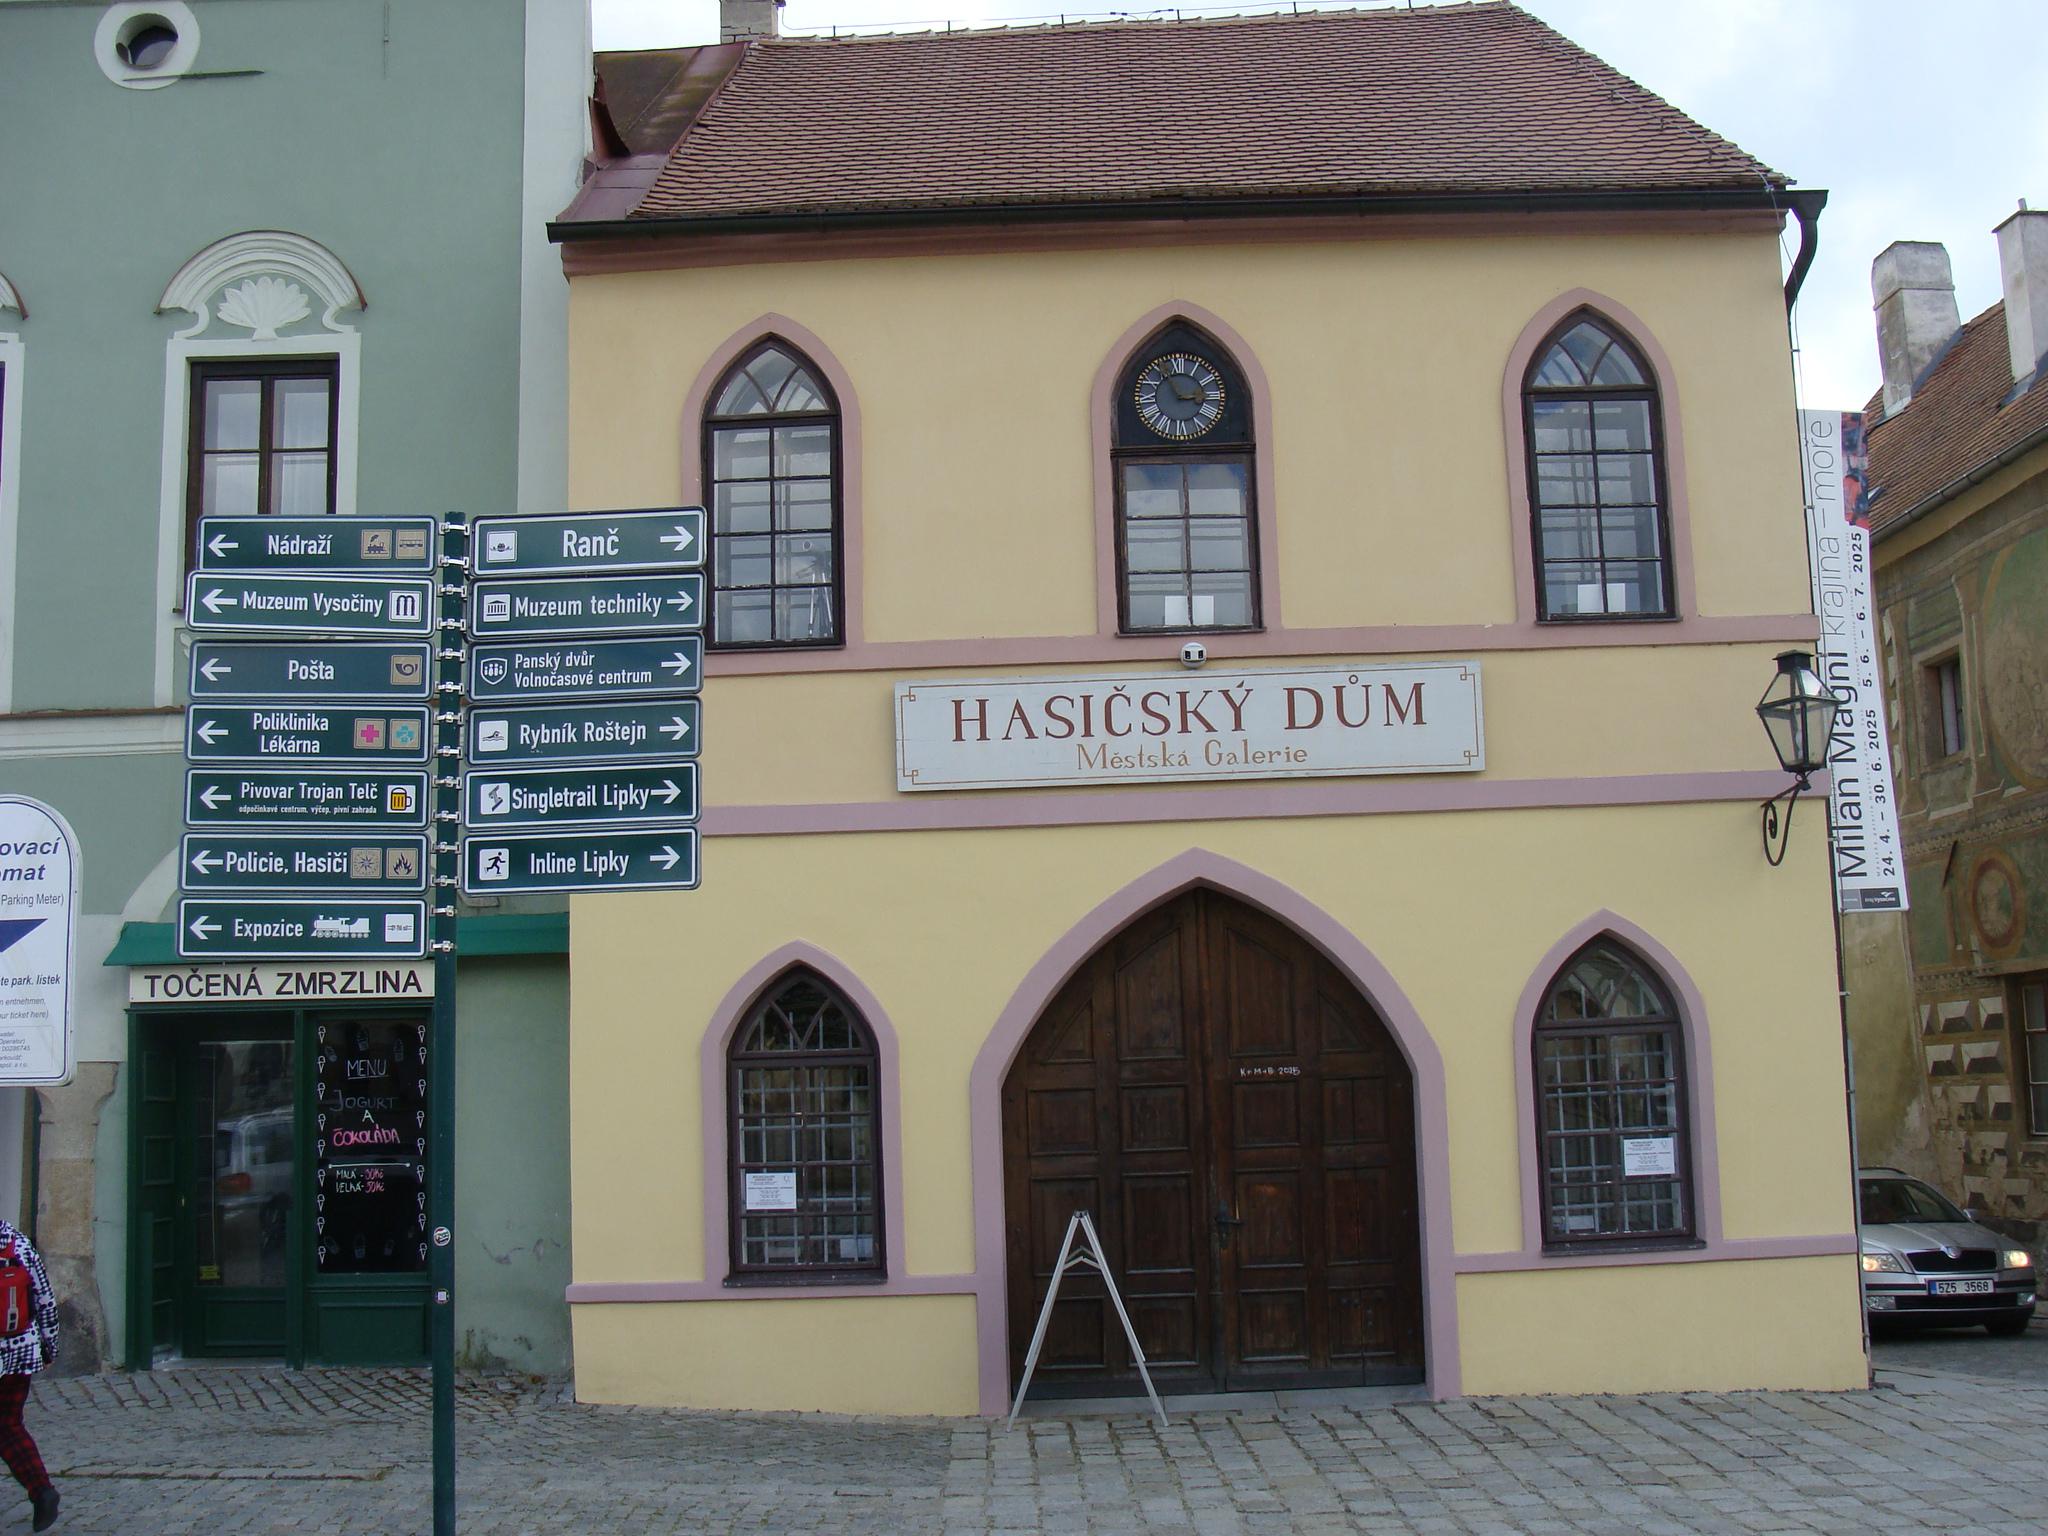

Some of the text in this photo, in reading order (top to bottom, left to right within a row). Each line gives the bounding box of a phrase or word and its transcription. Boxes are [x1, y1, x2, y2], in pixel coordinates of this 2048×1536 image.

[268, 534, 334, 556] Nádraží
[563, 528, 620, 557] Ranč
[1851, 533, 1863, 573] 2025
[1813, 537, 1847, 635] krajina
[1854, 581, 1865, 597] 7.
[242, 590, 309, 611] Muzeum
[313, 592, 384, 618] Vysočiny
[515, 592, 662, 618] Muzeum techniky
[1856, 605, 1866, 621] 6.
[515, 651, 595, 671] Panský dvůr
[1860, 647, 1870, 663] 6.
[288, 659, 335, 681] Pošta
[515, 669, 652, 688] Volnočasové centrum
[1862, 671, 1872, 687] 5.
[951, 674, 1427, 742] HASIČSKÝ DŮM
[253, 712, 329, 731] Poliklinika
[1865, 709, 1880, 750] 2025
[260, 734, 320, 753] Lékárna
[520, 720, 647, 749] Rybník Roštejn
[1076, 738, 1308, 770] Městská Galerie
[1871, 757, 1882, 772] 6.
[241, 782, 378, 803] Pivovar Trojan Telč
[512, 783, 650, 814] Singletrail Lipky
[1874, 778, 1887, 804] 30.
[239, 804, 278, 814] odpočinkové
[352, 805, 378, 814] zahrada
[1832, 778, 1867, 877] Milan
[1879, 828, 1891, 844] 4.
[0, 864, 46, 881] mat
[226, 852, 348, 874] Policie, Hasiči
[531, 850, 630, 877] Inline Lipky
[1882, 850, 1896, 876] 24.
[36, 893, 65, 905] Meter)
[234, 918, 304, 942] Expozice
[144, 967, 423, 998] TOČENÁ ZMRZLINA
[347, 1060, 388, 1077] MENU
[330, 1090, 400, 1111] JOGURT
[362, 1109, 374, 1123] A
[333, 1124, 400, 1146] ČOKOLÁDA
[1938, 1280, 1990, 1293] 5Z5 3568
